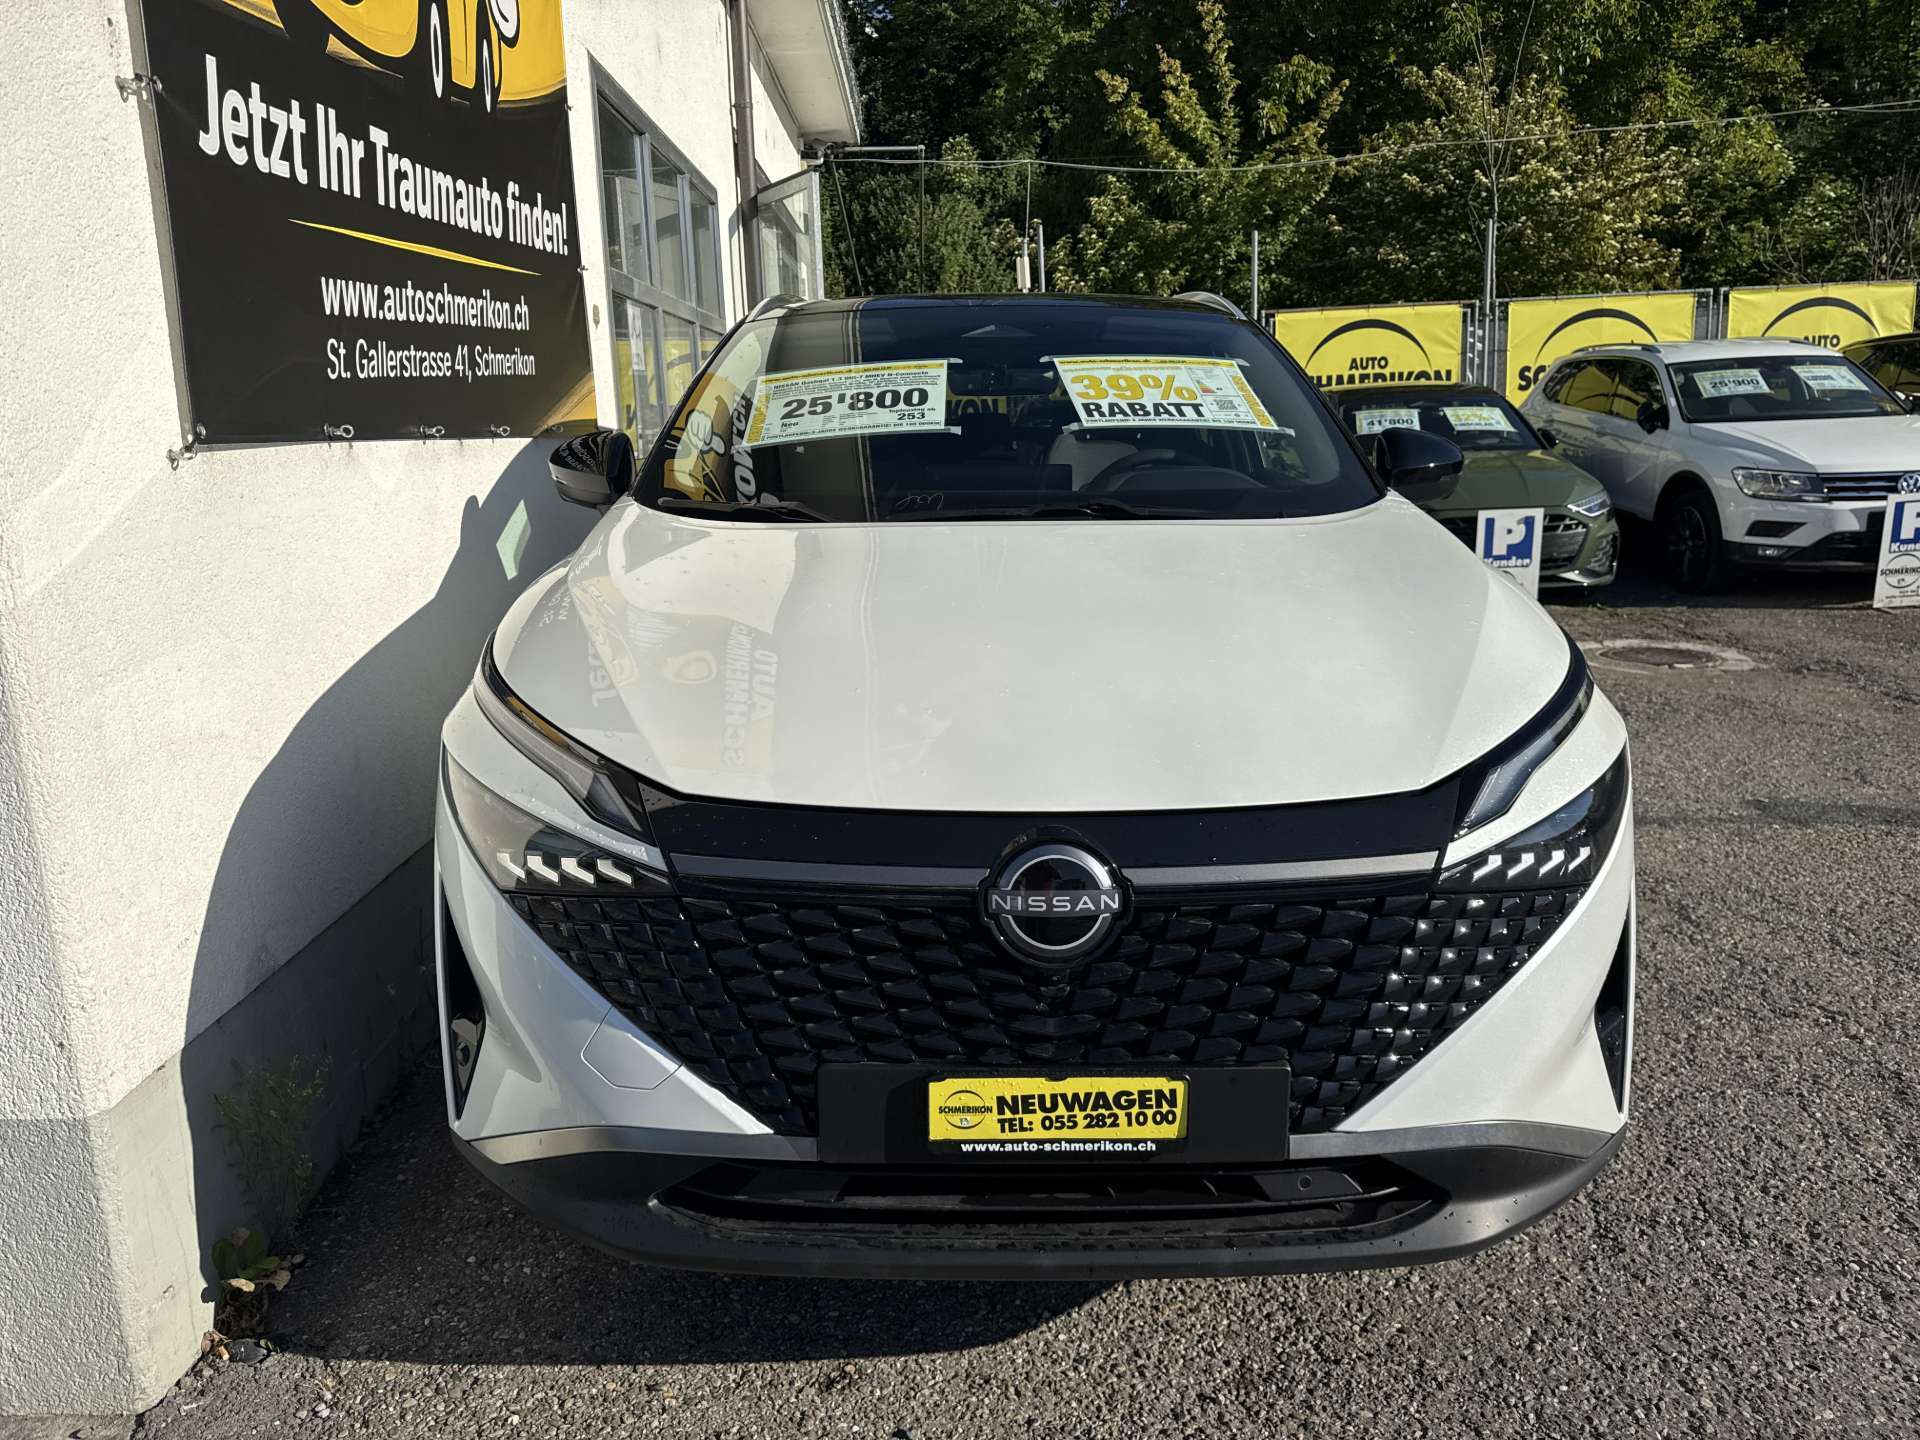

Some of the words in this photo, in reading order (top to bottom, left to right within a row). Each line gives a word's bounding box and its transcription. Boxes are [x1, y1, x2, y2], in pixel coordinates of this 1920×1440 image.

[198, 53, 308, 185] Jetzt
[316, 103, 364, 198] Ihr
[369, 123, 503, 239] Traumauto
[506, 180, 569, 256] finden!
[321, 276, 530, 331] www.autoschmerikon.ch
[326, 337, 351, 380] St.
[355, 339, 452, 379] Gallerstrasse
[454, 349, 472, 383] 41,
[474, 349, 536, 377] Schmerikon
[1349, 356, 1389, 371] AUTO
[1071, 373, 1198, 401] 39%
[780, 387, 929, 421] 25'800
[1081, 402, 1204, 418] RABATT
[897, 412, 926, 421] 253
[992, 892, 1118, 912] NISSAN
[938, 1104, 993, 1114] SCHMERIKON
[996, 1088, 1178, 1116] NEUWAGEN
[997, 1117, 1034, 1133] TEL:
[1040, 1115, 1078, 1131] 055
[1083, 1113, 1120, 1129] 282
[1124, 1110, 1148, 1127] 10
[1152, 1109, 1177, 1125] 00
[961, 1140, 1156, 1152] www.auto-schmerikon.ch
